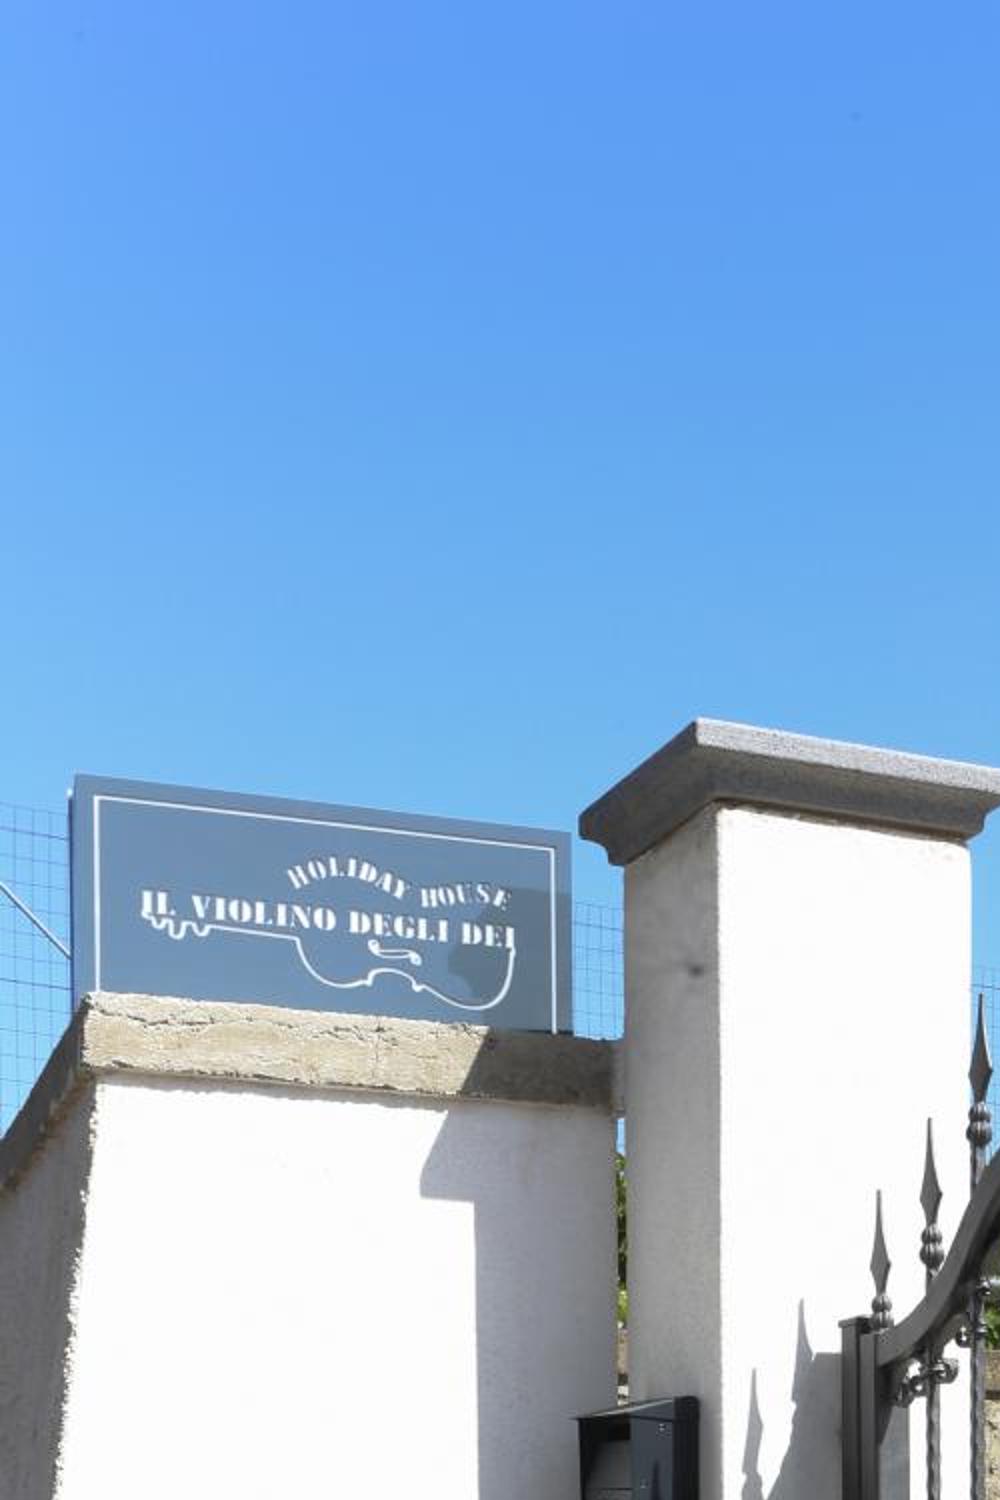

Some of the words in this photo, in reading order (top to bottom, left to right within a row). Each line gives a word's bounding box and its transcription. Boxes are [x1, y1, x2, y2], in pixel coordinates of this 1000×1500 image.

[286, 856, 413, 901] HOLIDAY
[420, 882, 512, 912] HOUSE
[140, 889, 177, 918] IL
[191, 894, 337, 932] VIOLINO
[348, 909, 449, 945] DEGLI
[461, 921, 516, 950] DEI
